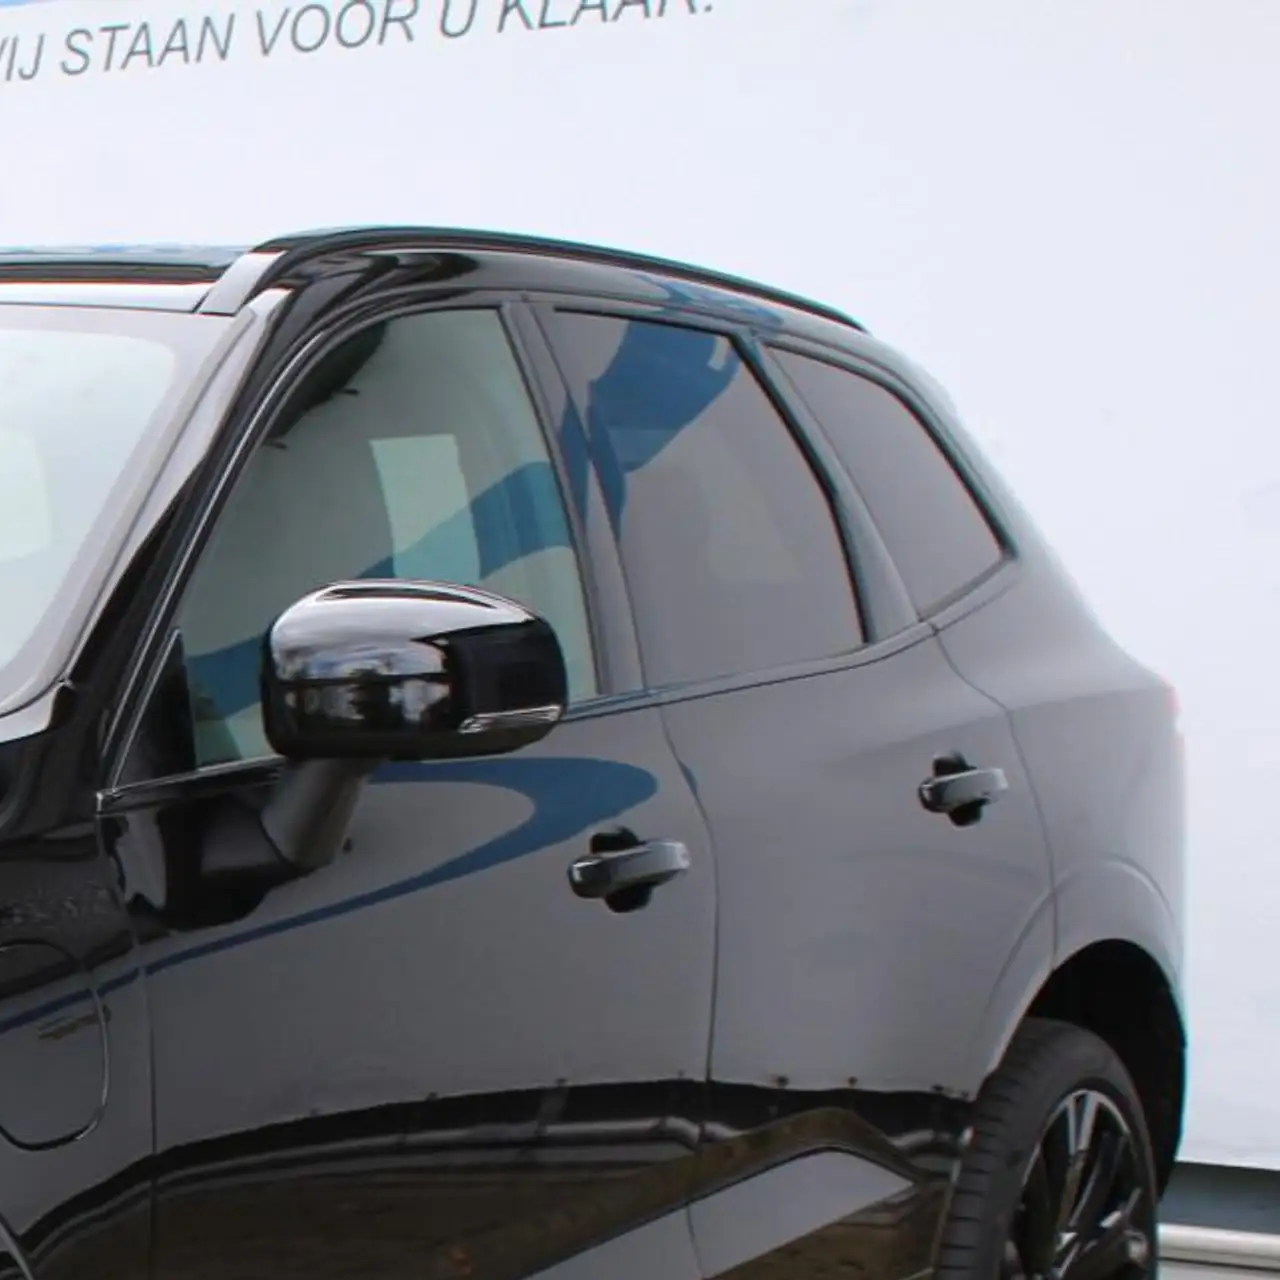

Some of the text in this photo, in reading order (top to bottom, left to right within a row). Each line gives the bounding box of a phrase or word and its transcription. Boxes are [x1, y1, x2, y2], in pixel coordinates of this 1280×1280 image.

[61, 13, 236, 76] STAAN
[256, 0, 415, 56] VOOR
[440, 0, 477, 38] U
